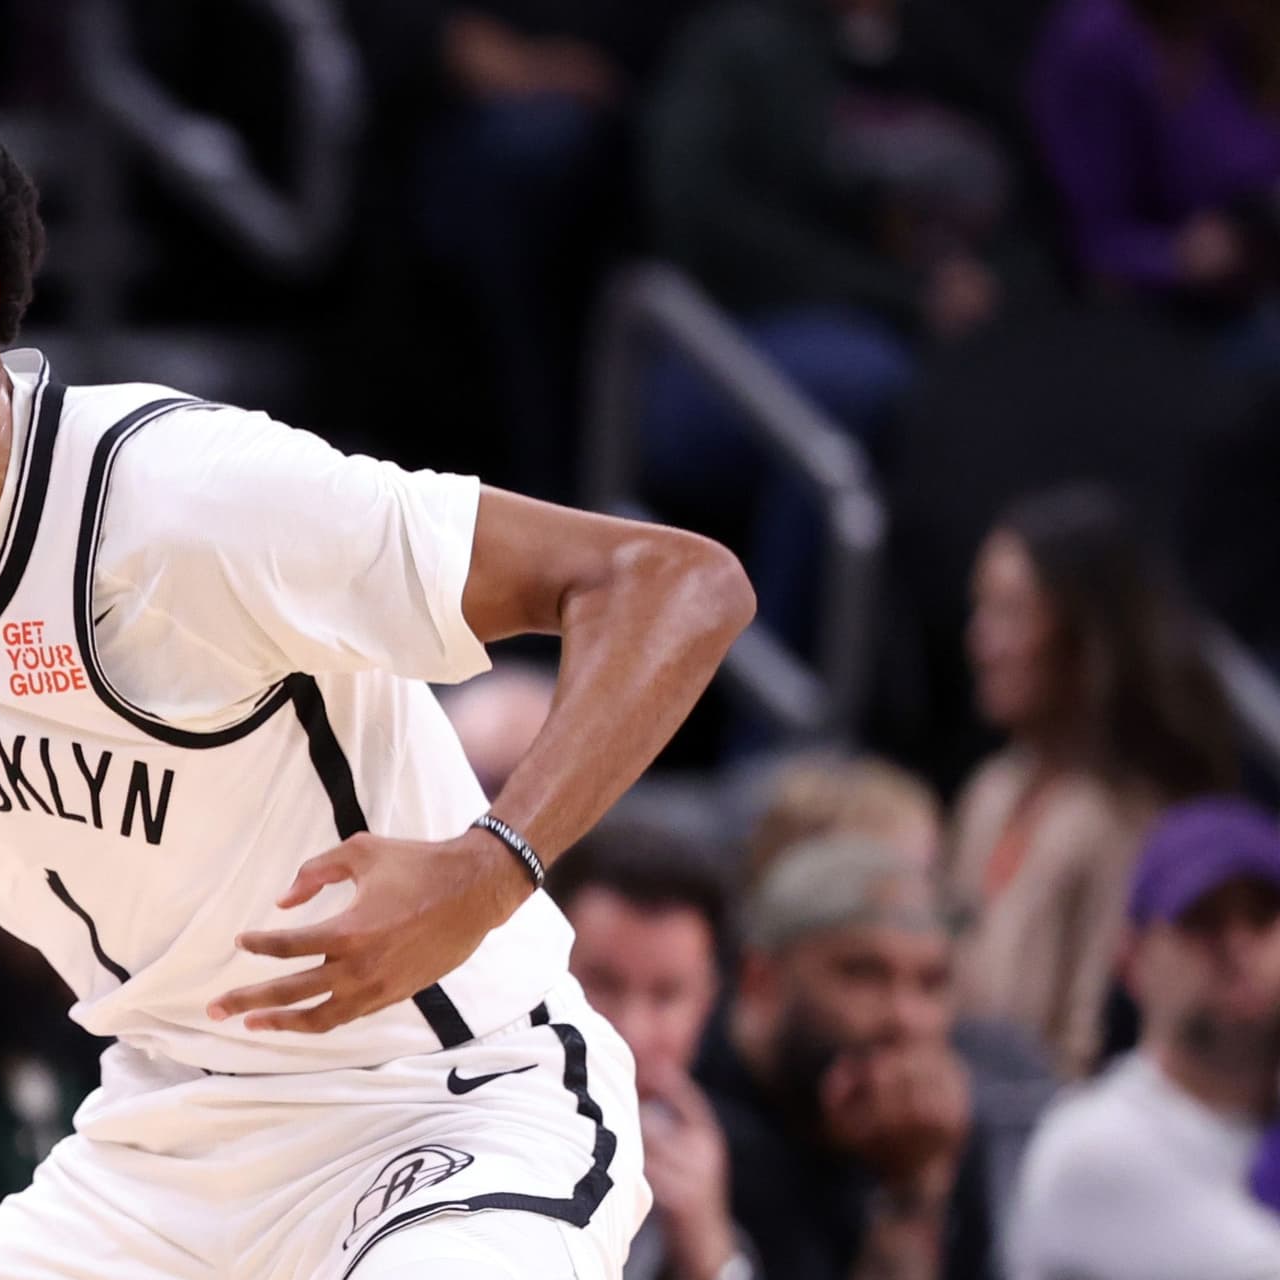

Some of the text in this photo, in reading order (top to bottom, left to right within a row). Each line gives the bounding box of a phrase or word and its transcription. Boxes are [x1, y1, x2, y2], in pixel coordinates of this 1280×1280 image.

[2, 620, 44, 646] GET
[6, 644, 76, 671] YOUR
[9, 668, 87, 697] GUIDE
